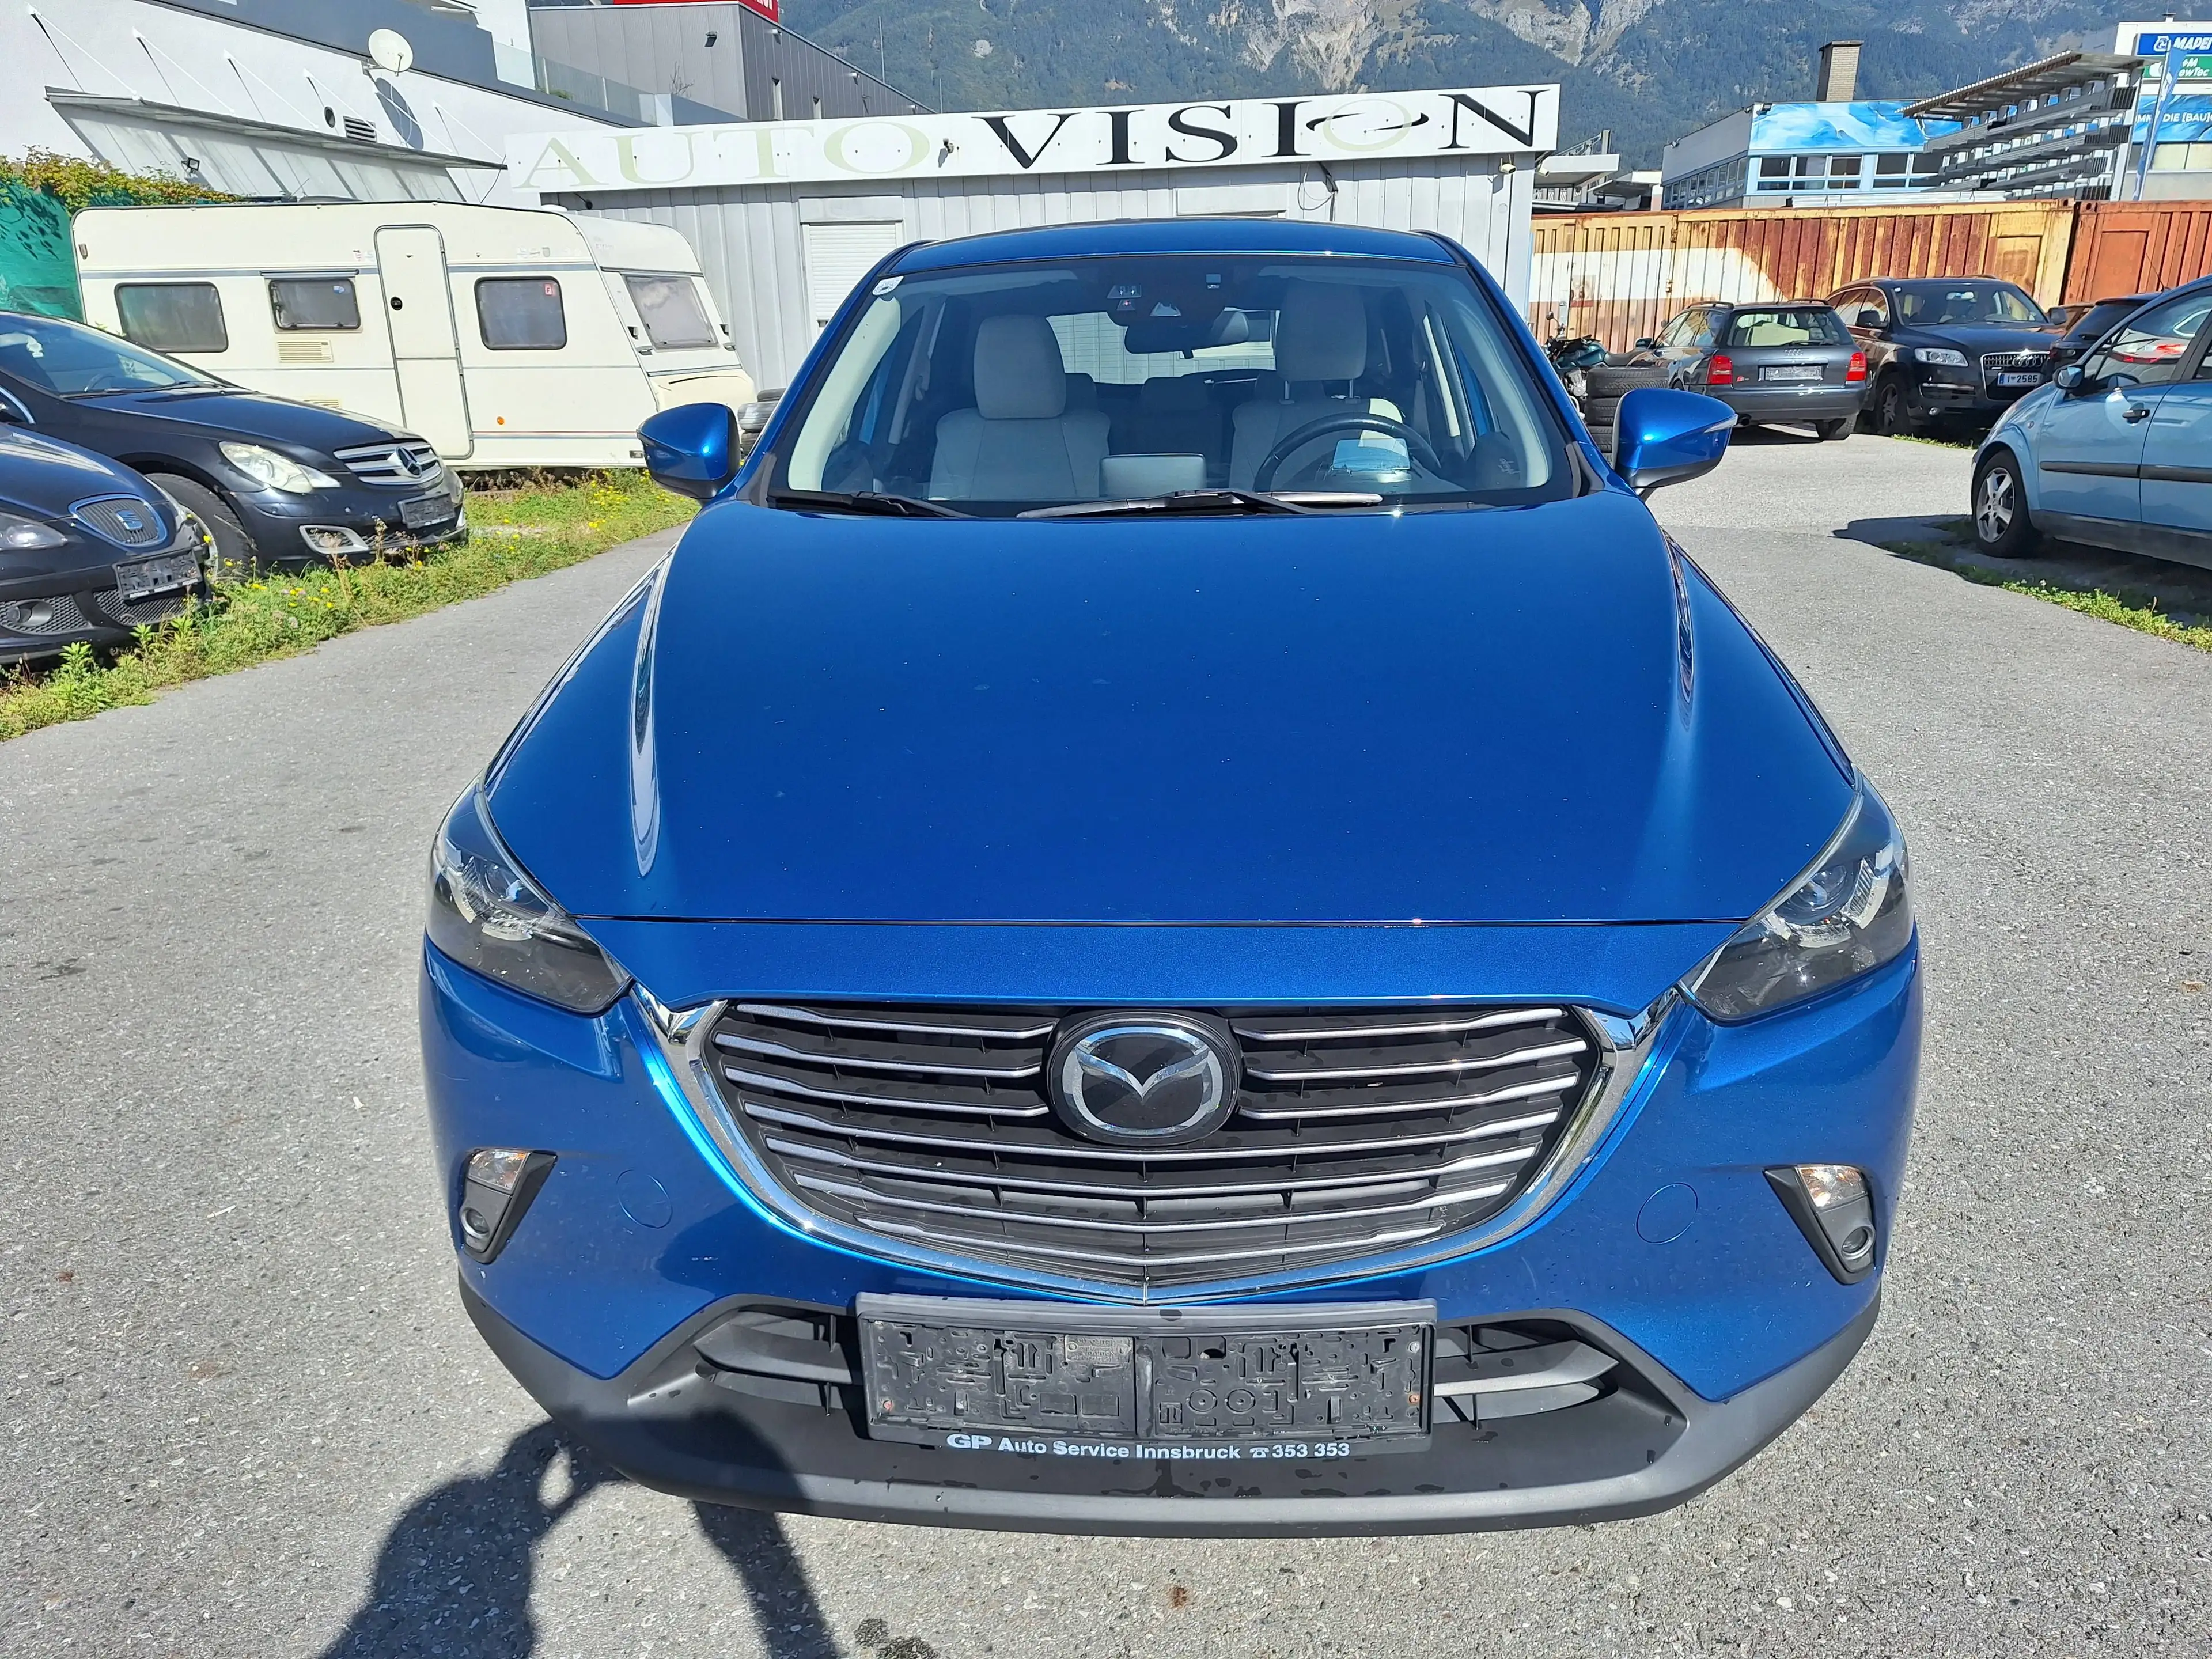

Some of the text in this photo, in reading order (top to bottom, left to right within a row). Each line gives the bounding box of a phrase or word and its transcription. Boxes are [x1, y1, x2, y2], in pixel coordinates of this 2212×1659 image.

[2173, 37, 2212, 50] MAPEI
[2162, 113, 2180, 122] DIE
[2181, 112, 2212, 123] [BAU]
[513, 89, 1551, 189] AUTO VISION
[2017, 374, 2037, 383] 2585
[946, 1433, 1350, 1459] GP Auto Service Innsbruck 353 353
